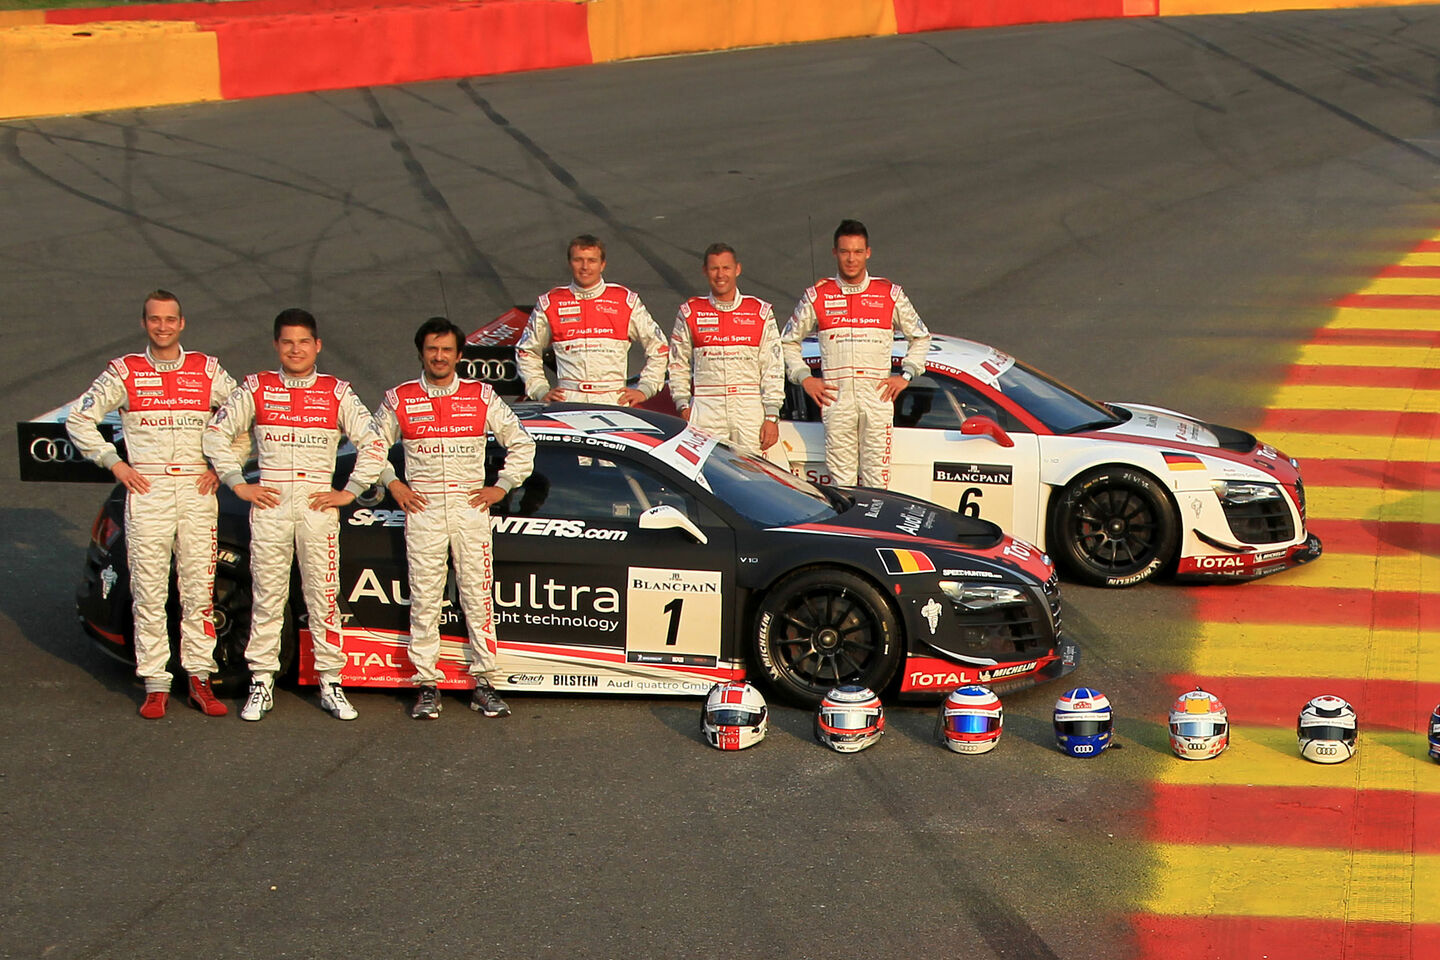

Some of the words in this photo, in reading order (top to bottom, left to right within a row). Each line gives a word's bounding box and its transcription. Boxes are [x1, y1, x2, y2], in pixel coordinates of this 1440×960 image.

[925, 361, 962, 375] otterer
[153, 398, 177, 407] Audi
[178, 398, 202, 406] Sport
[140, 417, 173, 426] Audi
[177, 417, 204, 426] ultra
[279, 414, 302, 422] Audi
[303, 415, 328, 423] Sport
[427, 425, 448, 433] Audi
[450, 425, 473, 433] Sport
[264, 432, 295, 443] Audi
[299, 434, 328, 445] ultra
[586, 437, 626, 452] Ortelli
[416, 444, 444, 454] Audi
[449, 445, 476, 454] ultra
[937, 471, 1010, 483] BLANCPAIN
[958, 487, 983, 518] 6
[208, 525, 218, 575] Sport
[326, 533, 336, 583] Sport
[482, 541, 492, 591] Sport
[1194, 556, 1245, 568] TOTAL
[1108, 568, 1152, 585] MICHELIN
[494, 573, 620, 613] ultra
[633, 579, 717, 593] BLANCPAIN
[324, 588, 336, 625] Audi
[482, 596, 492, 634] Audi
[524, 612, 619, 632] technology
[663, 598, 684, 646] 1
[759, 613, 772, 667] MICHELIN
[345, 652, 402, 668] TAL
[992, 661, 1037, 678] MICHELIN
[553, 675, 598, 687] BILSTEIN
[607, 680, 634, 689] Audi
[637, 681, 679, 691] quattro
[910, 670, 972, 687] TOTAL
